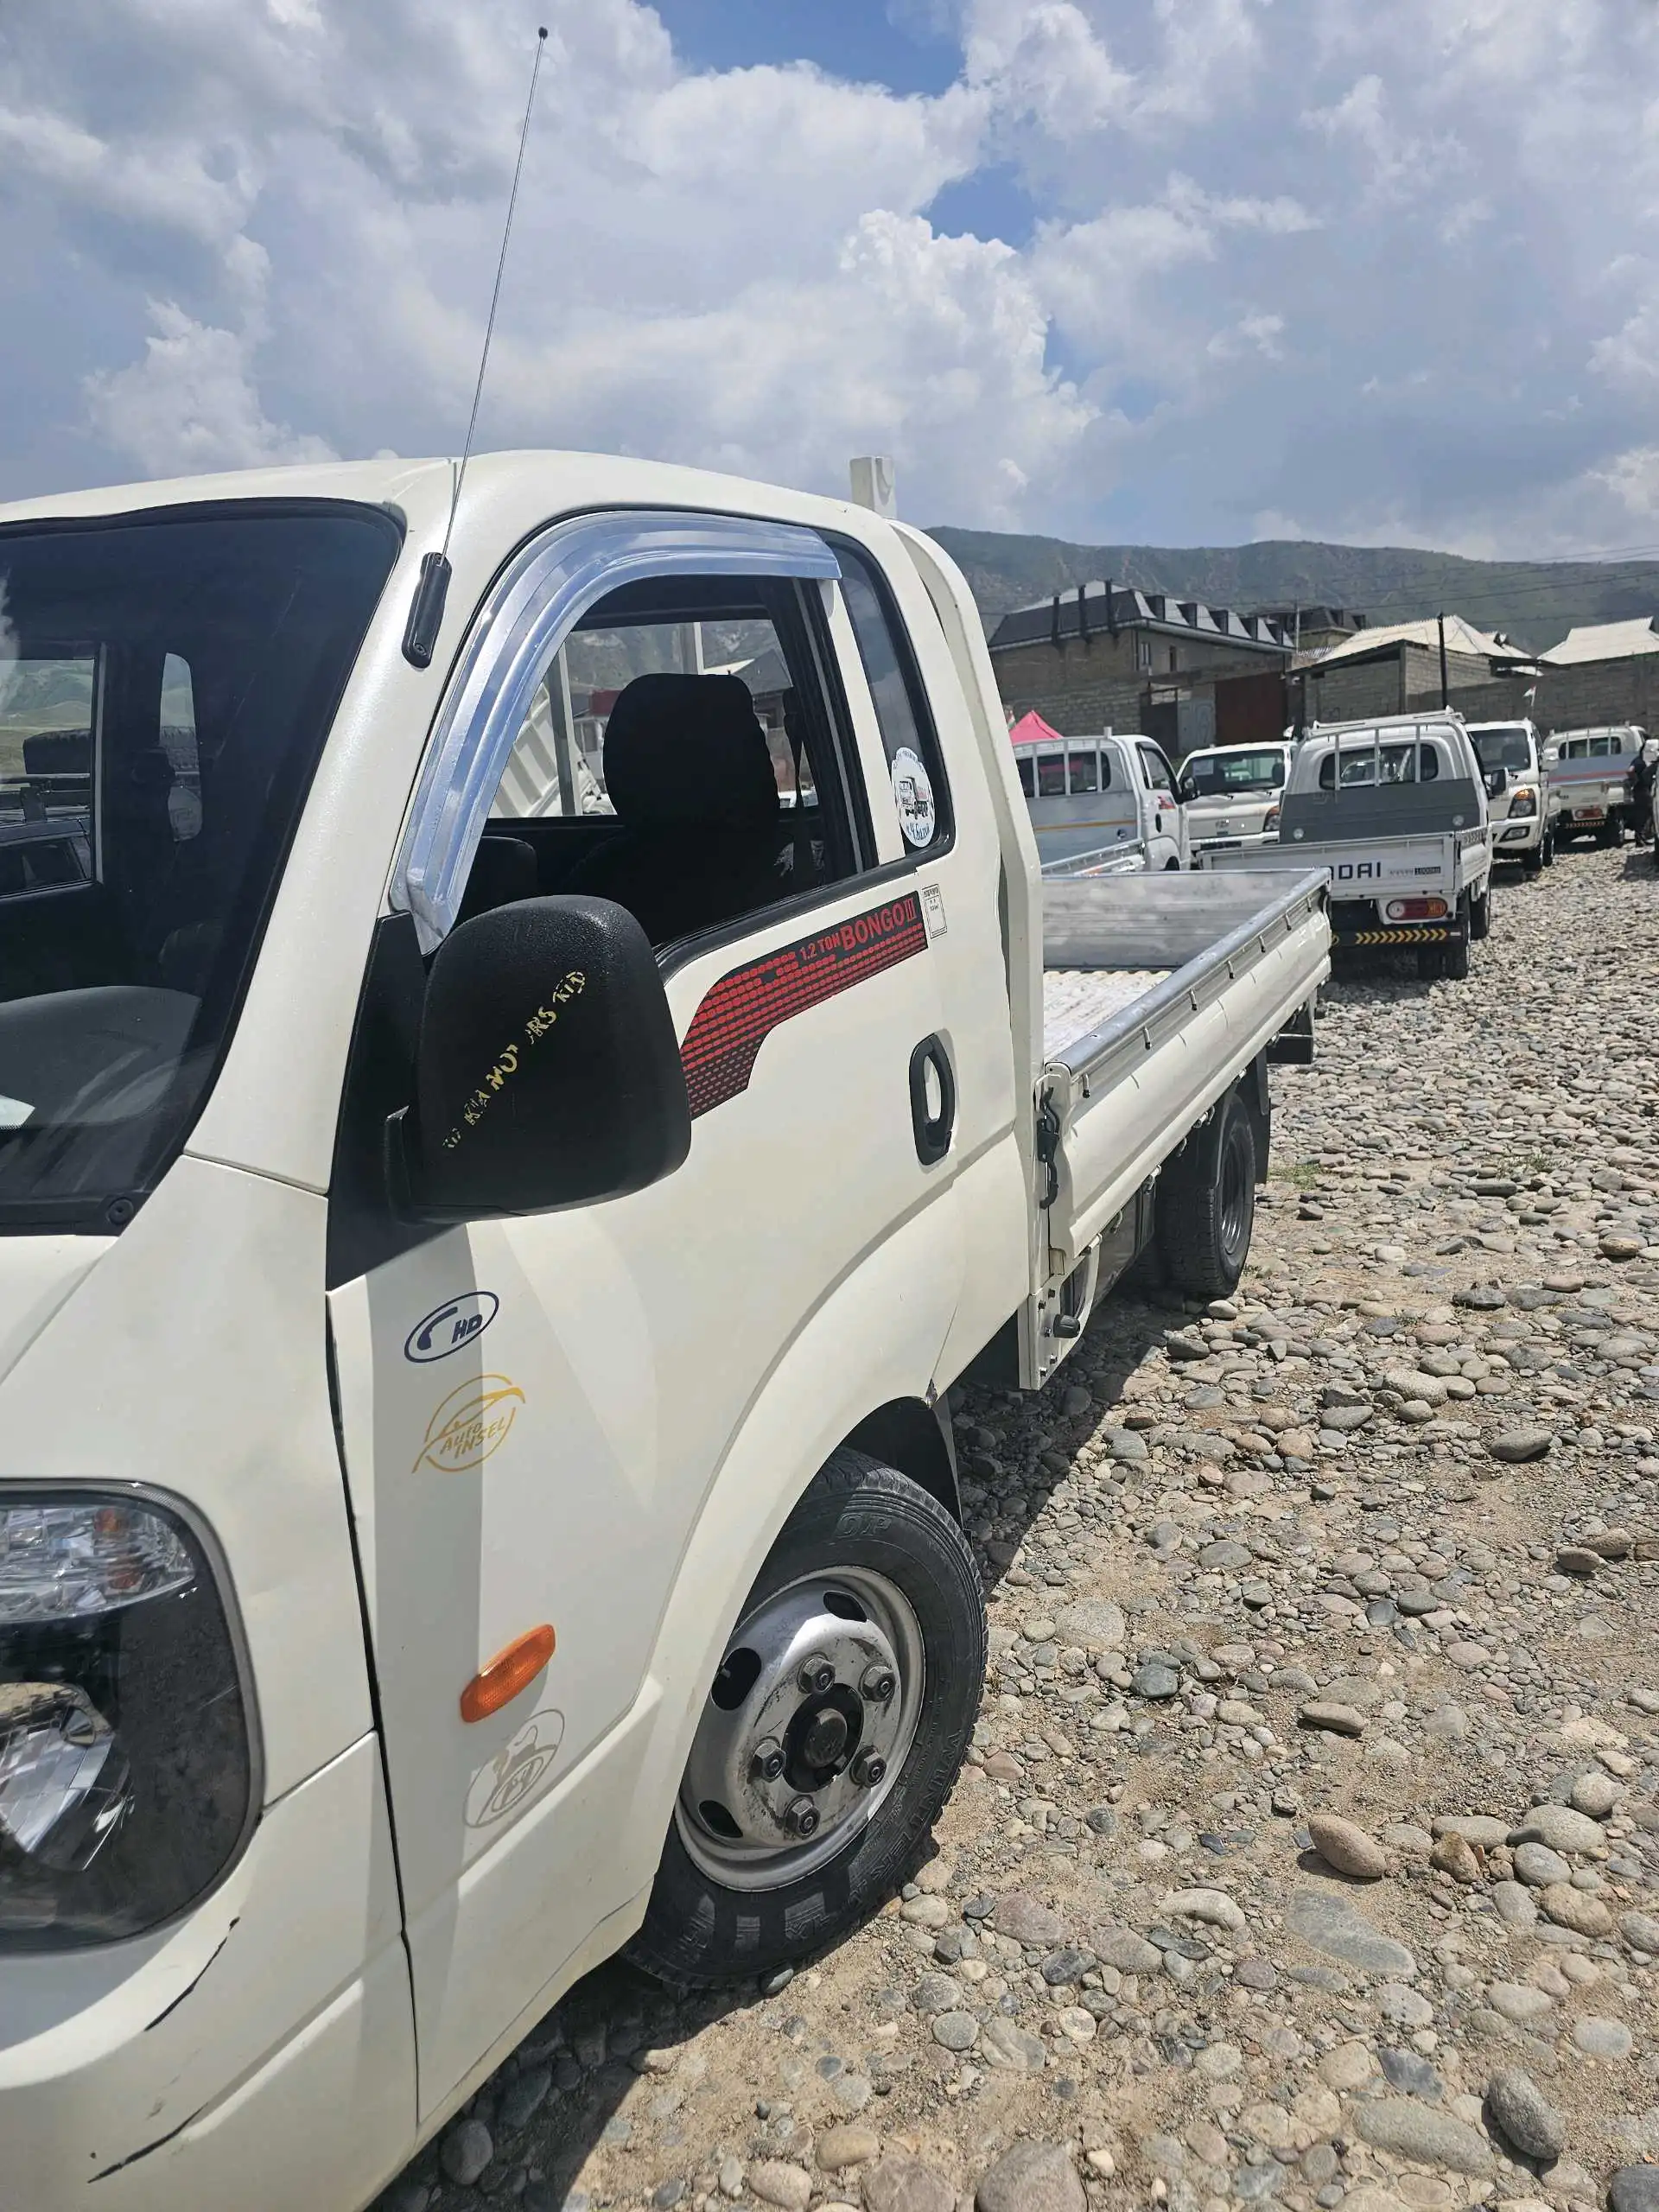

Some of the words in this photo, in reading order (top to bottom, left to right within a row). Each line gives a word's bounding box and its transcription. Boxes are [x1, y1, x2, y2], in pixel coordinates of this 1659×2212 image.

[800, 943, 817, 961] 1.2
[817, 932, 842, 953] TON
[451, 1313, 483, 1344] HD
